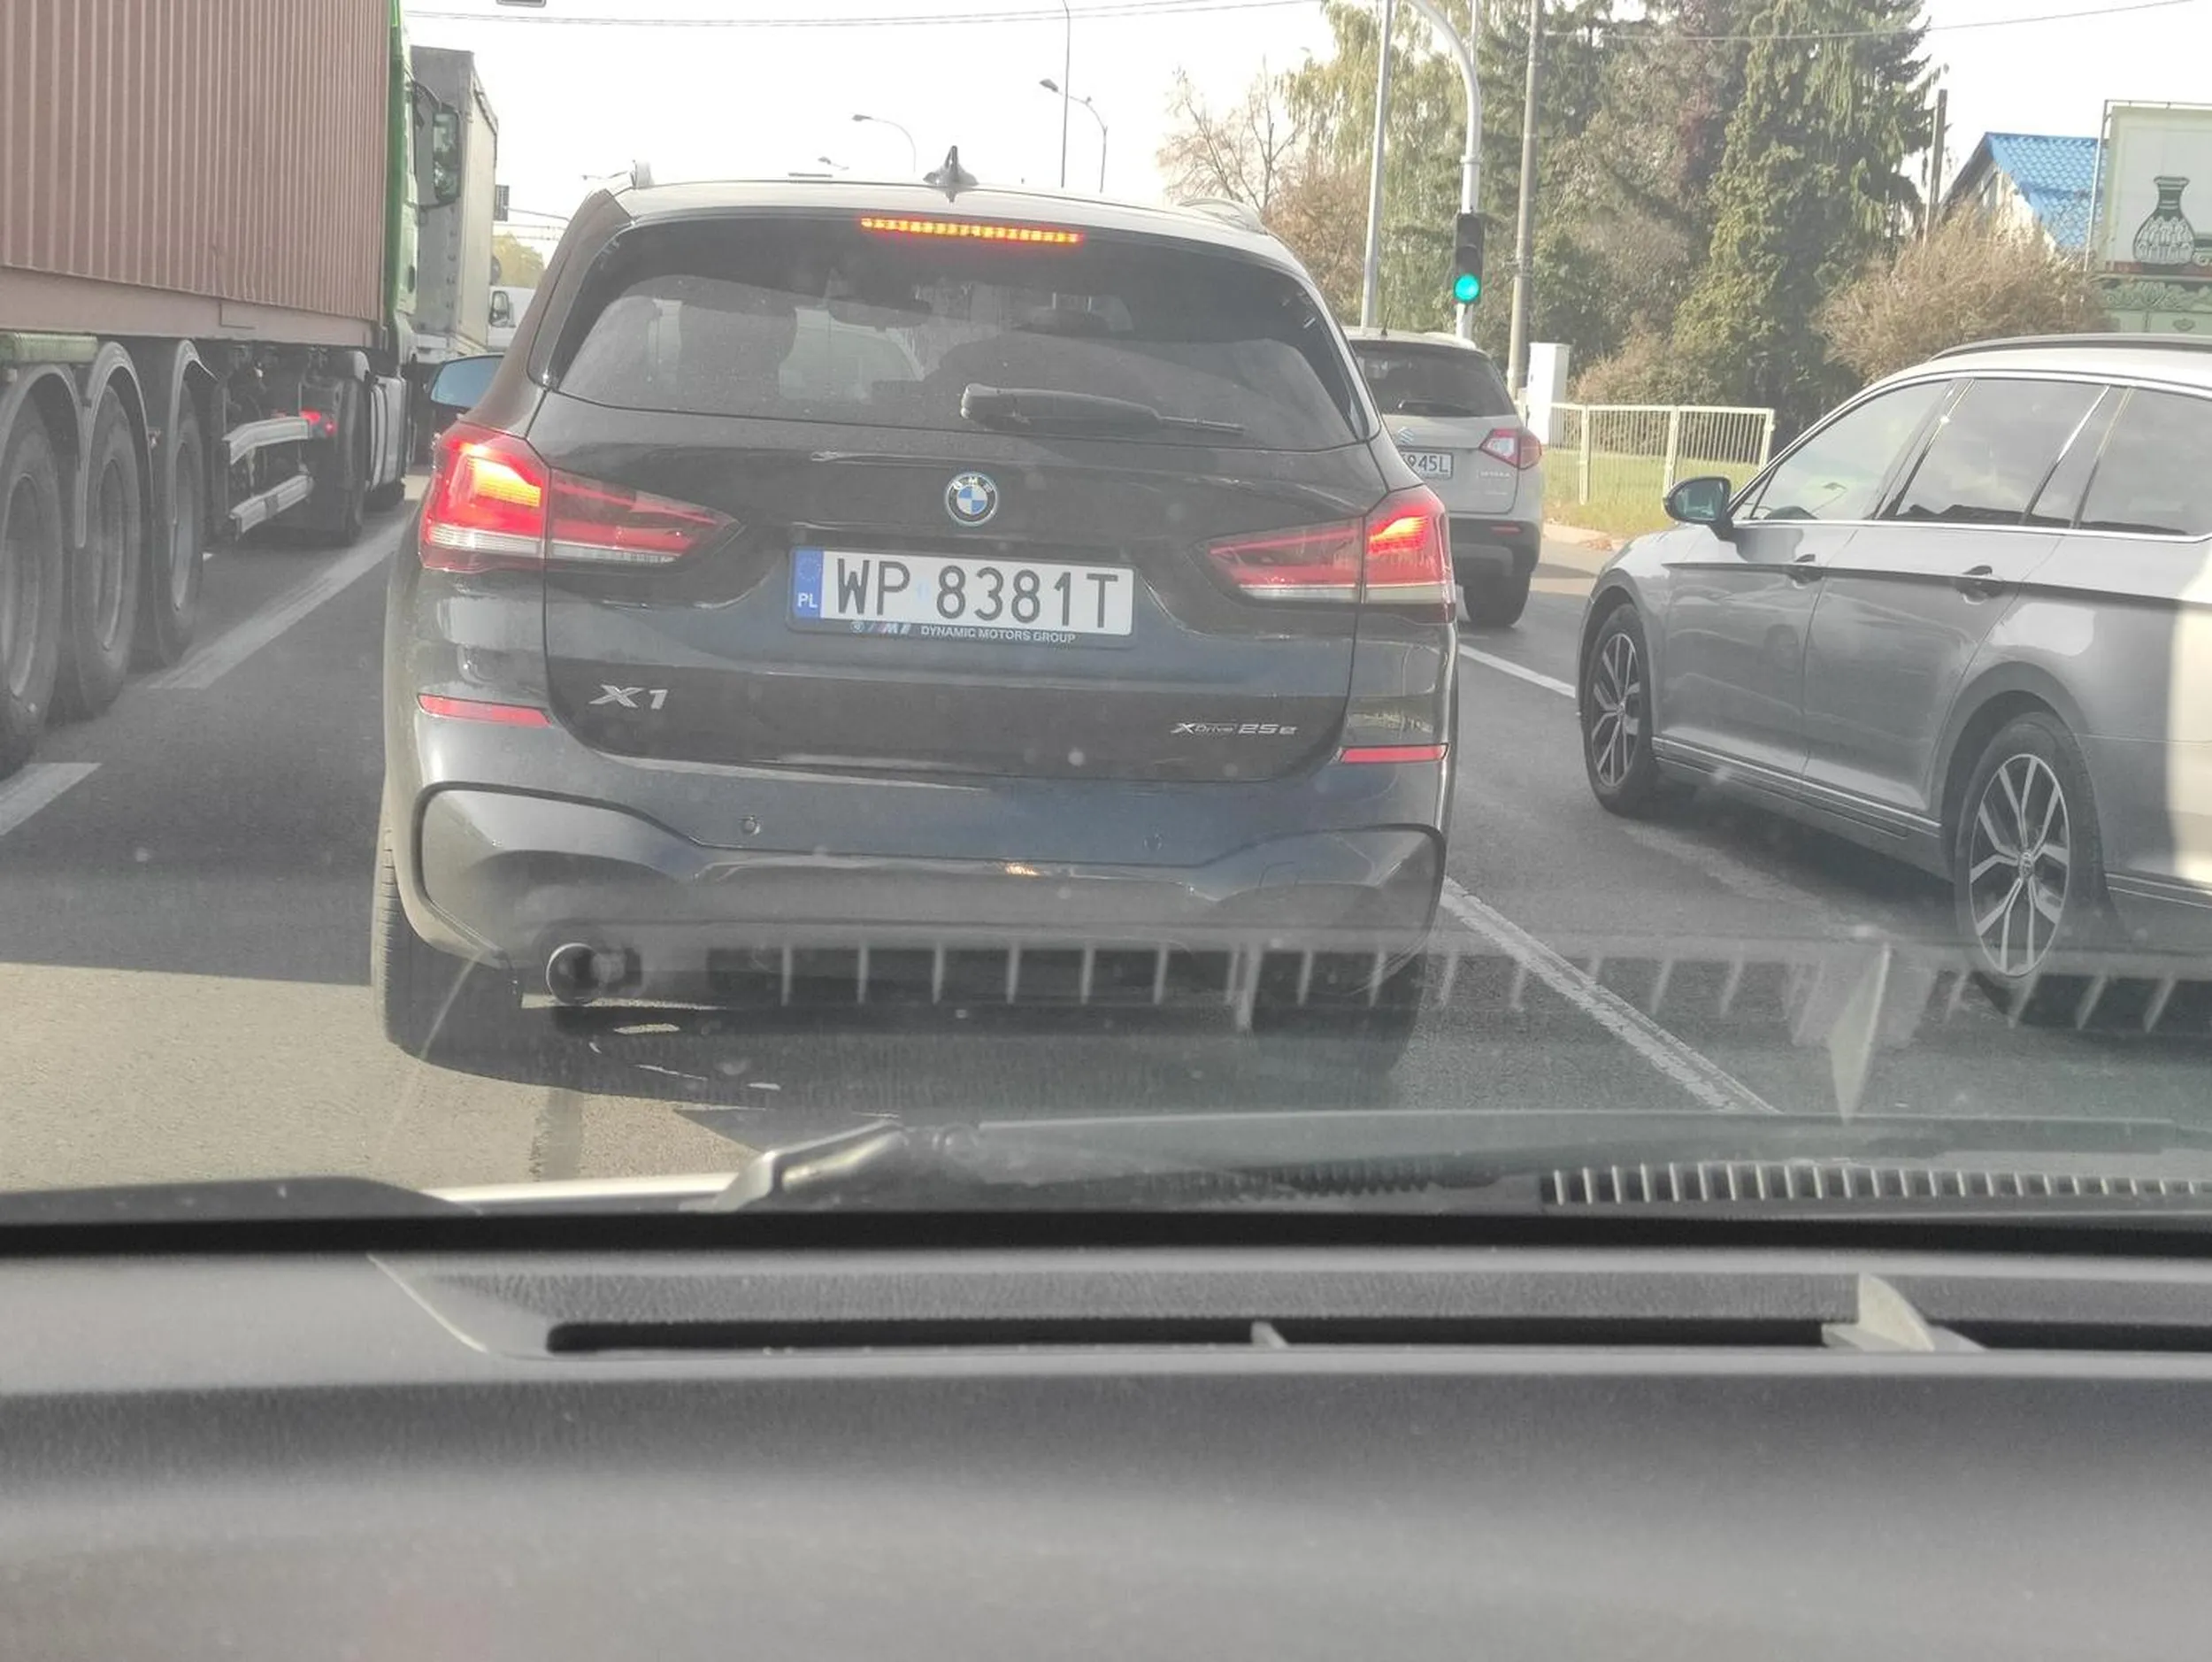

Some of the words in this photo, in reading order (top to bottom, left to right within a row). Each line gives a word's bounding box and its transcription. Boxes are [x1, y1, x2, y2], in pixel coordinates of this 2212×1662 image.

[797, 593, 818, 608] PL
[837, 558, 910, 615] WP
[936, 565, 1118, 628] 8381T
[921, 625, 976, 638] DYNAMIC
[978, 628, 1031, 642] MOTORS
[1033, 631, 1076, 643] GROUP
[588, 683, 668, 710] X1
